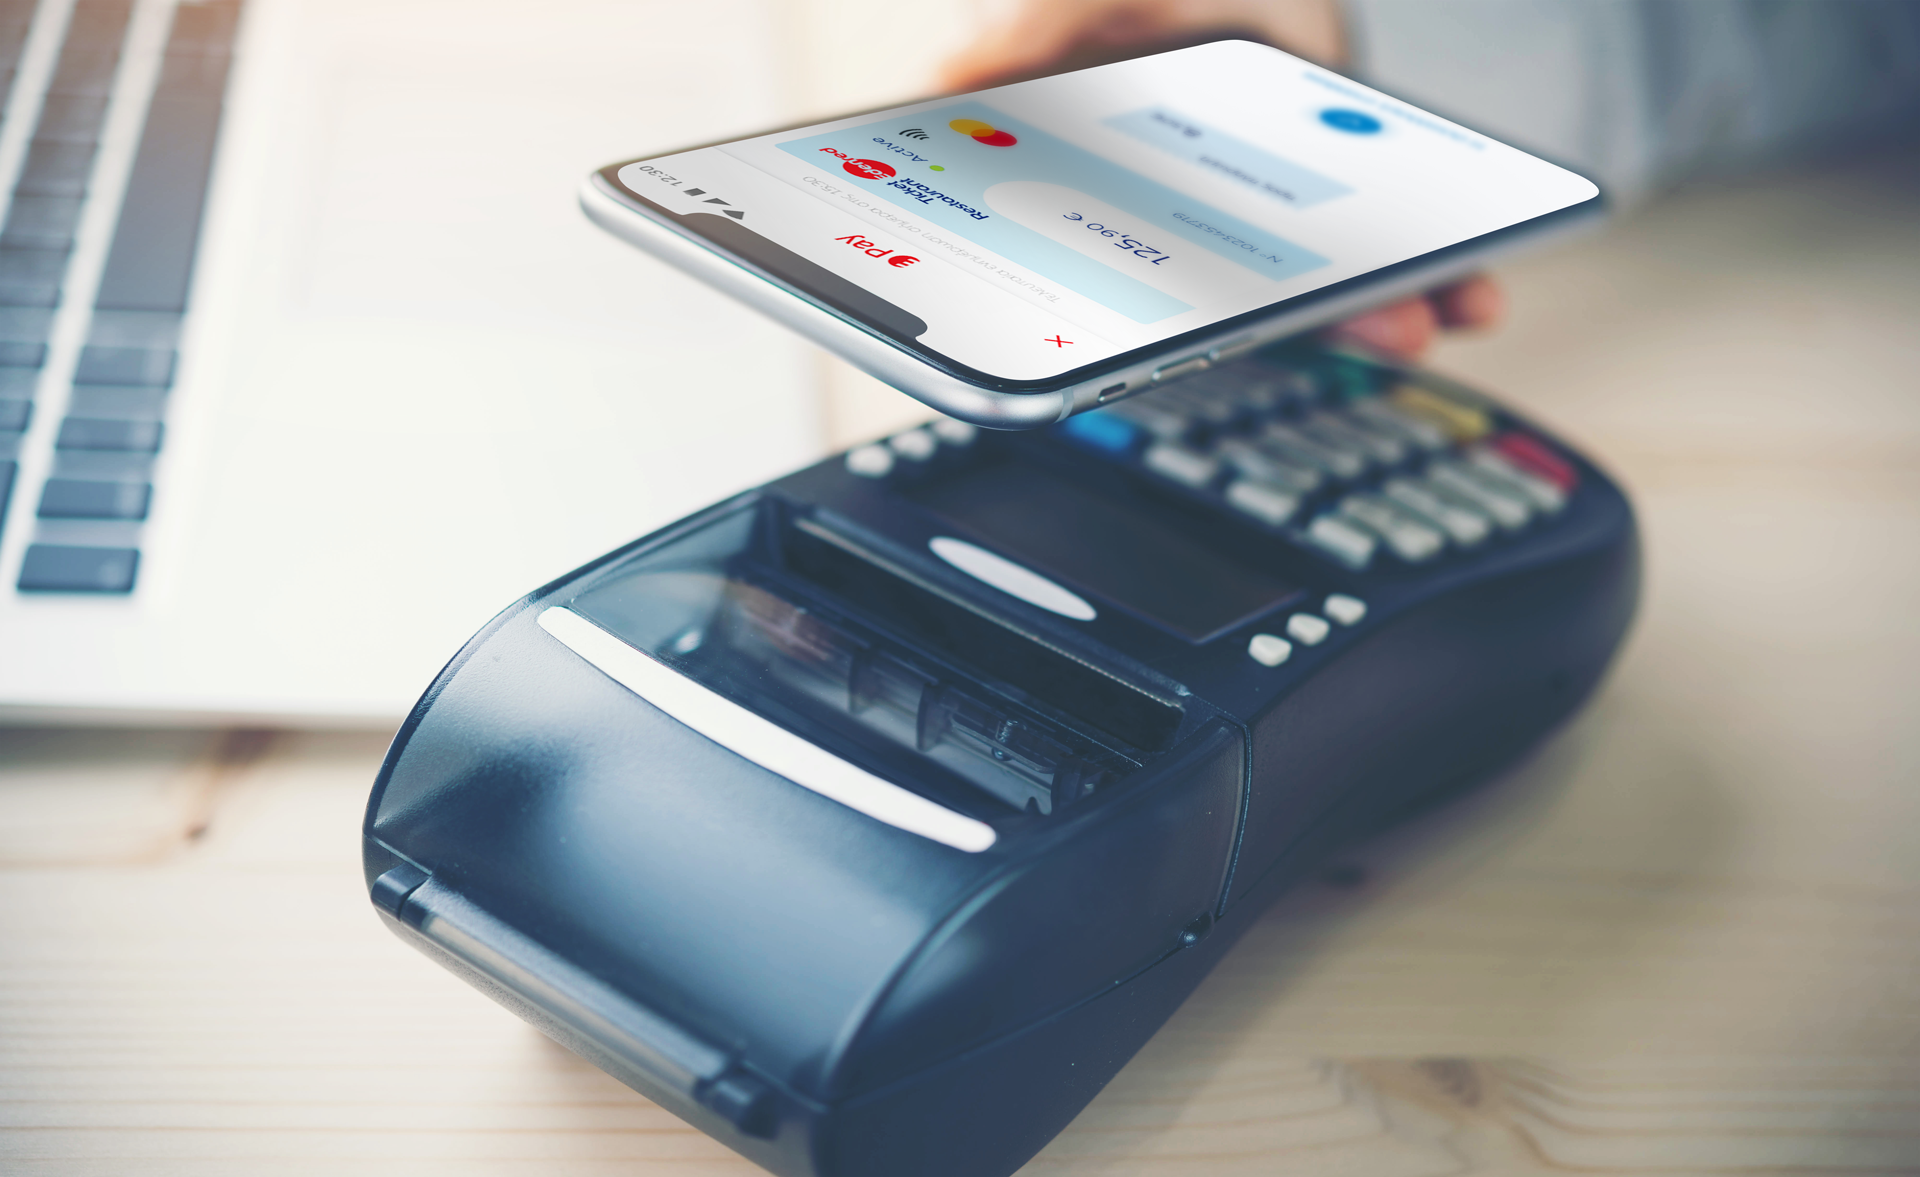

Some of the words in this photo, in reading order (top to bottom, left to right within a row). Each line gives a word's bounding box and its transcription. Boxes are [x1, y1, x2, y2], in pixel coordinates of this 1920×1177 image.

[872, 137, 929, 162] Active
[818, 147, 890, 180] Edenred
[638, 165, 683, 187] 12:30
[802, 176, 843, 195] 15:30
[887, 181, 934, 204] Ticket
[900, 177, 990, 220] Restaurant
[1062, 212, 1083, 222] €
[834, 234, 894, 258] Pay
[1086, 222, 1171, 266] 125,90
